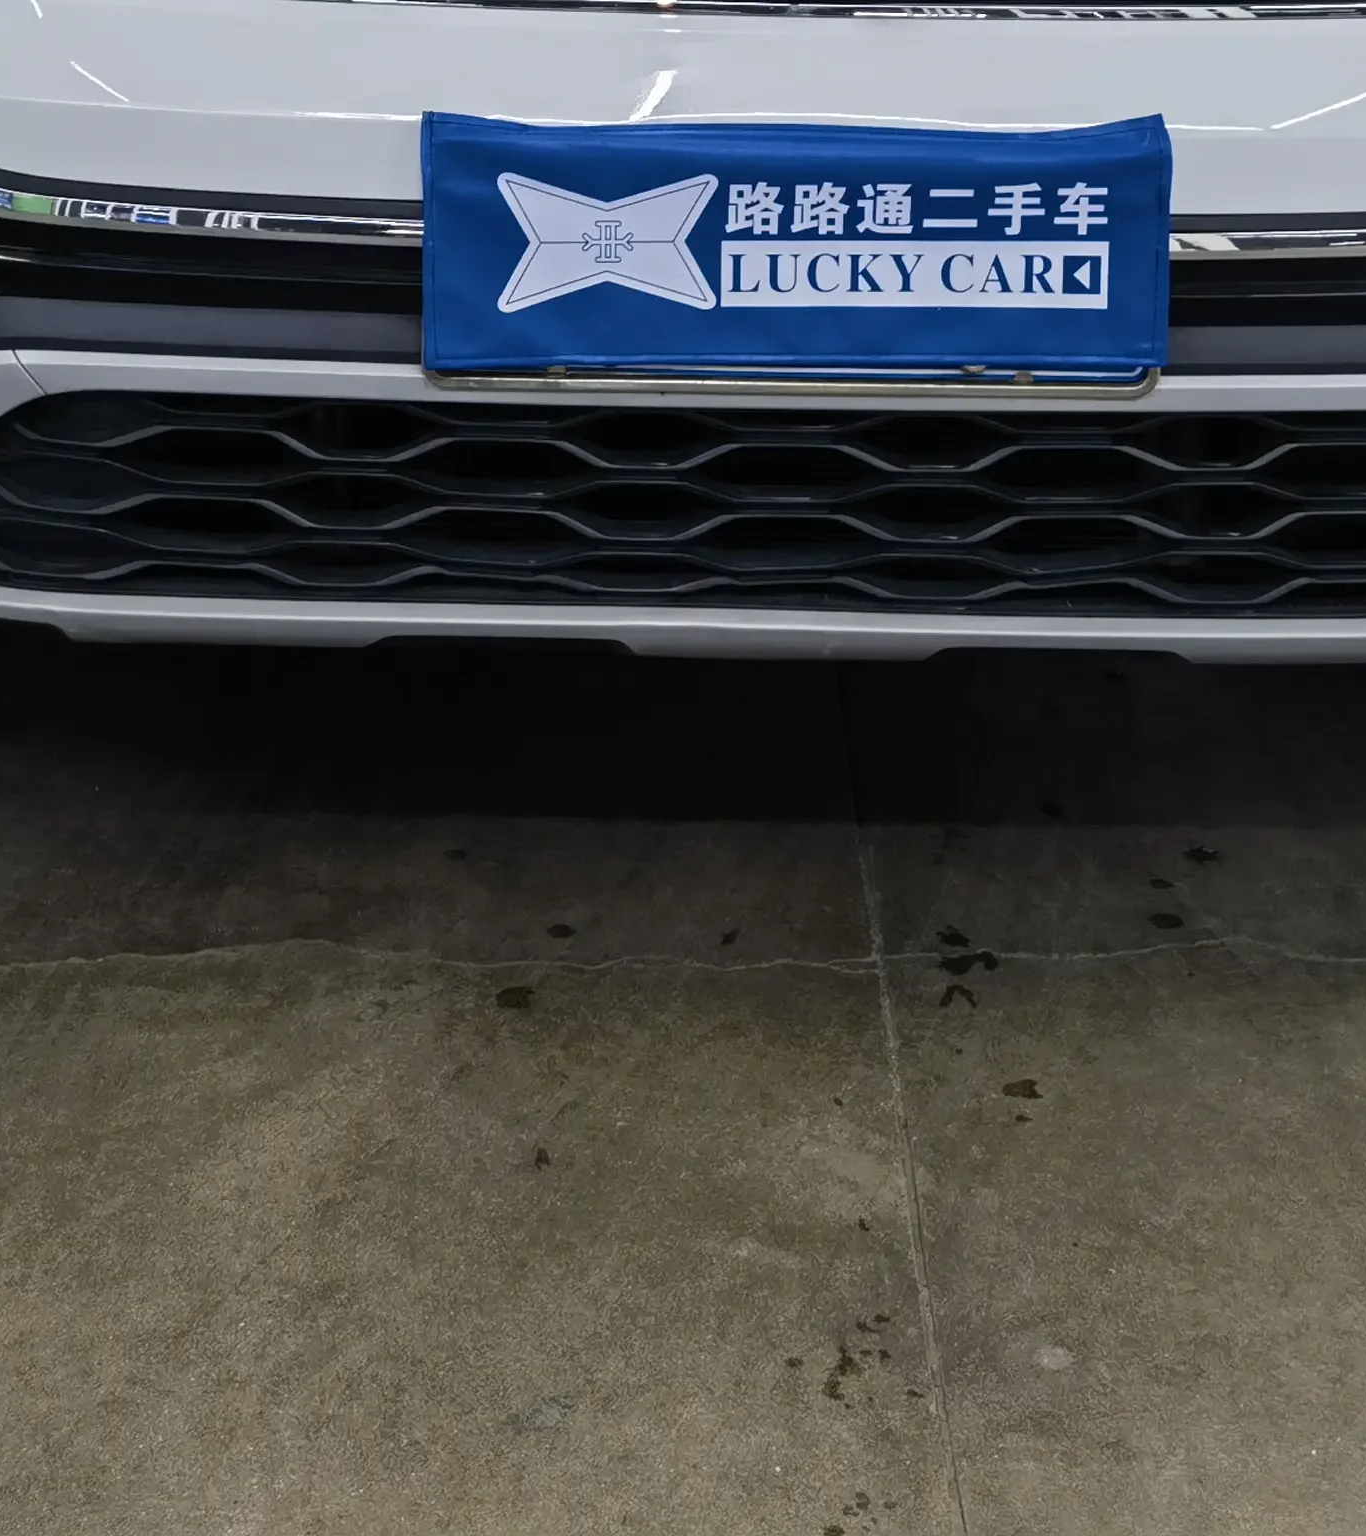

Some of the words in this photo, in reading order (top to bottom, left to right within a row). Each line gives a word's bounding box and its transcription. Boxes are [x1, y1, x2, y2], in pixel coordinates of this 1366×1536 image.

[724, 181, 1110, 236] 路路通二手车
[727, 252, 926, 294] LUCKY
[940, 252, 1056, 295] CAR
